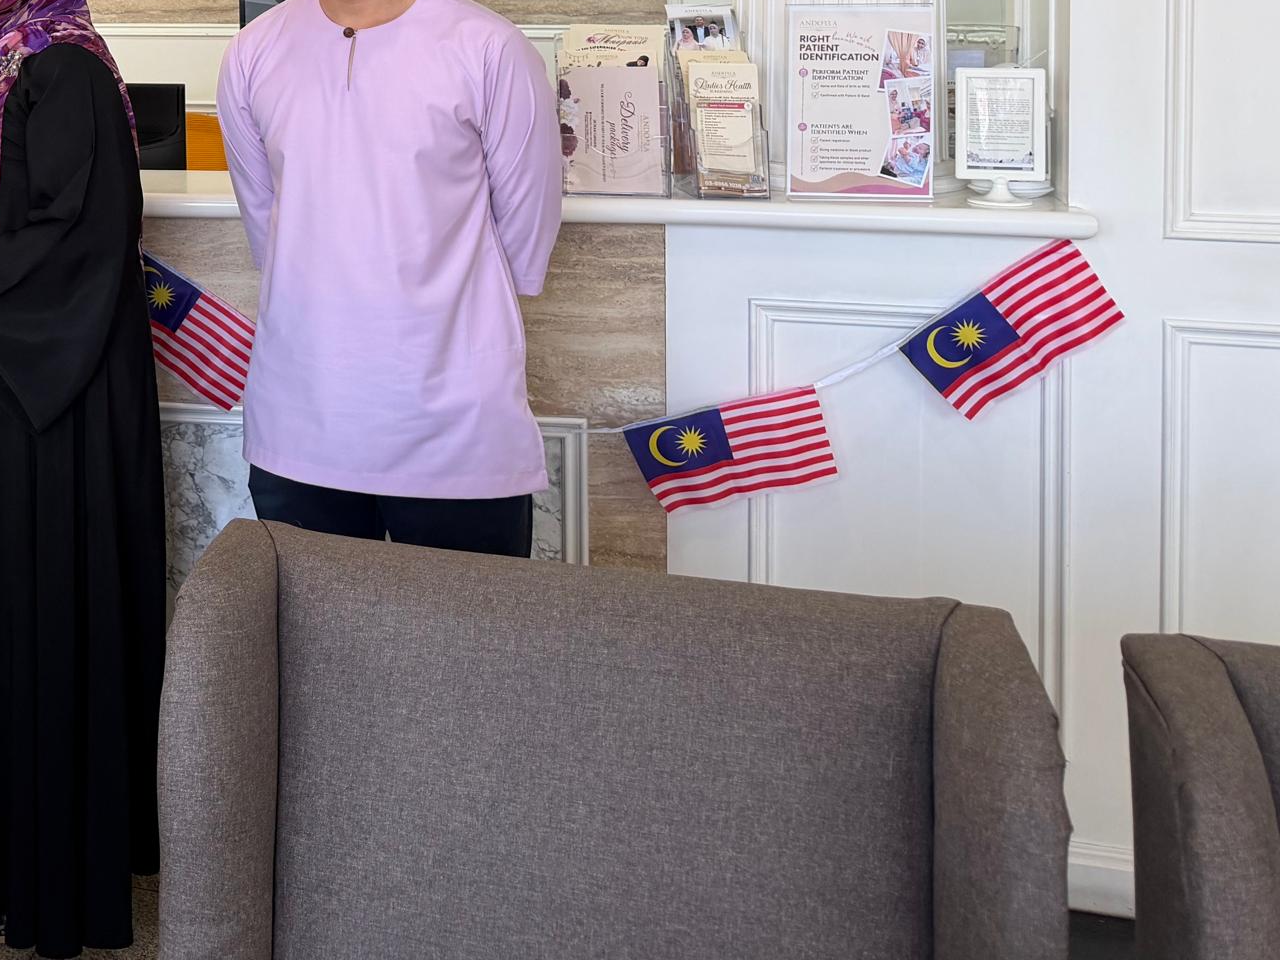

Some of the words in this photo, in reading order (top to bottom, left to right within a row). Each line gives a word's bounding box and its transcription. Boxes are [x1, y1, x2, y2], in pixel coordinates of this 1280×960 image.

[799, 34, 831, 43] RIGHT
[799, 44, 840, 52] PATIENT
[799, 53, 880, 61] IDENTIFICATION
[620, 91, 636, 153] Delivery
